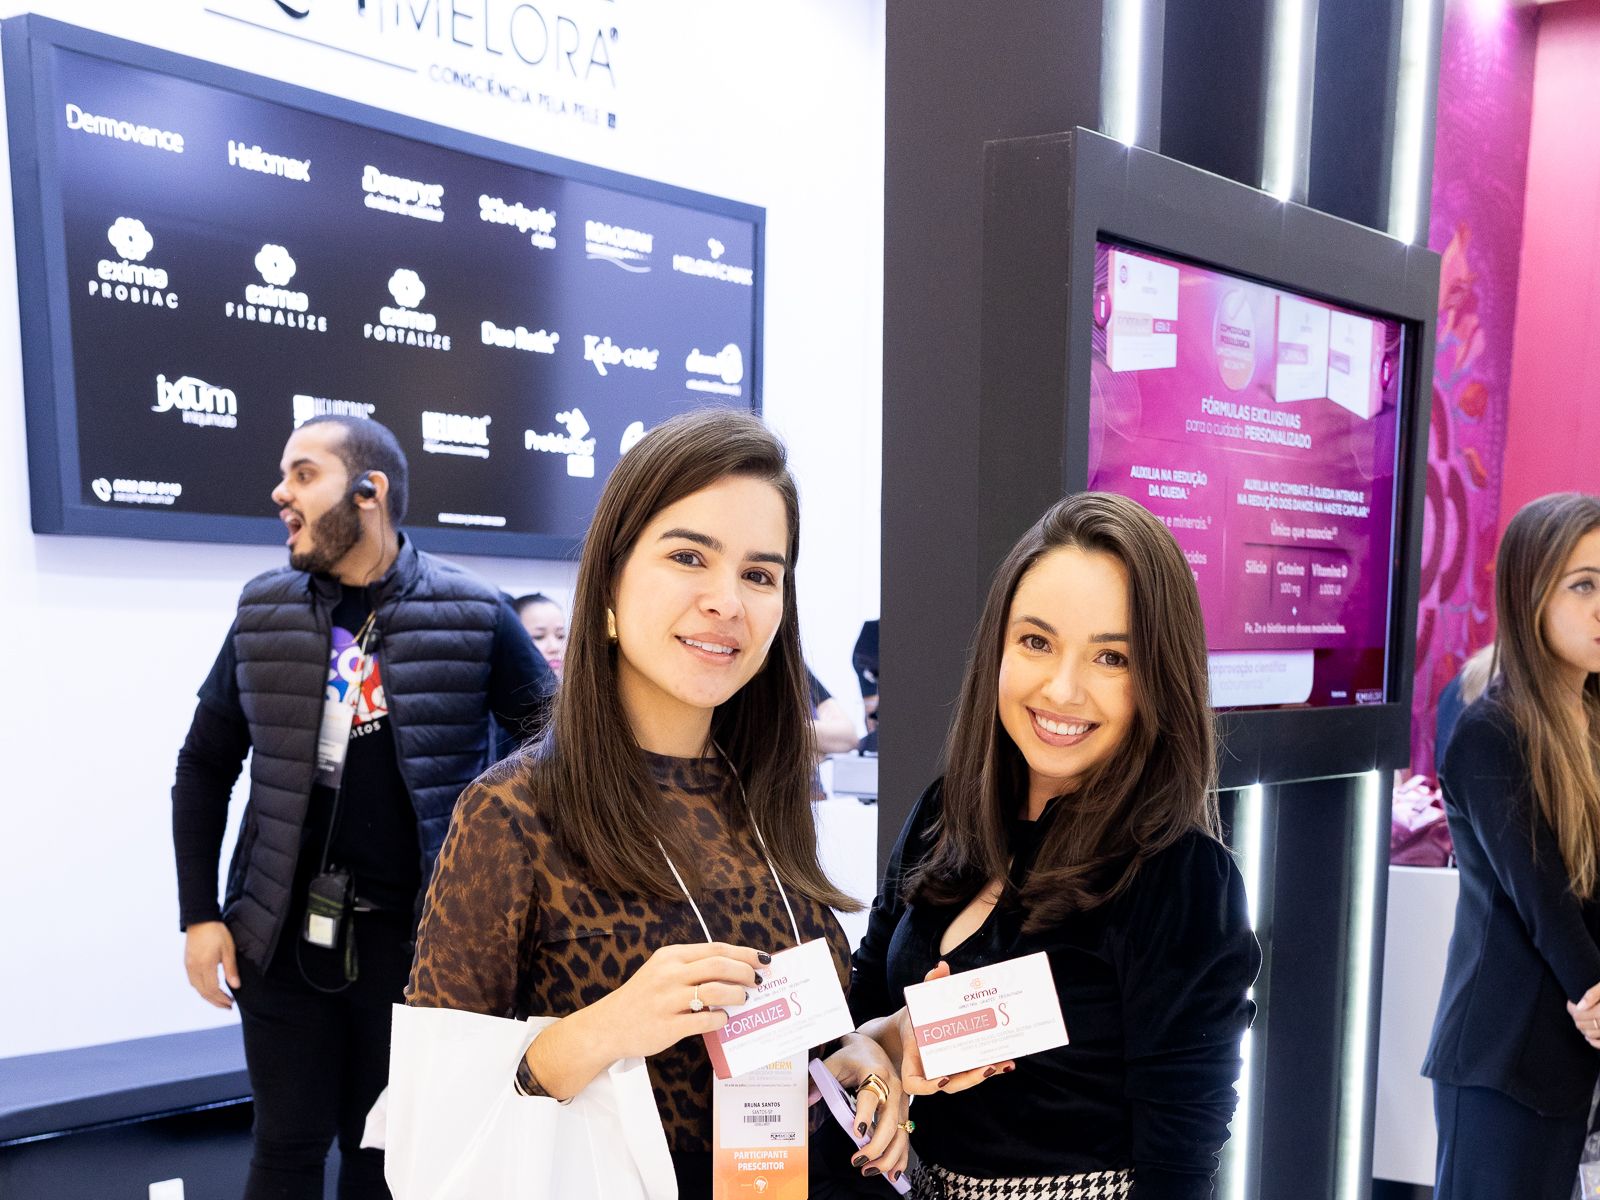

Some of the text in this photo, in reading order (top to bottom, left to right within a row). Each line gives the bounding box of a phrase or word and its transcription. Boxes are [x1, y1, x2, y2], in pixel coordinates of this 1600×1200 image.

[66, 103, 184, 153] Dermovance
[88, 279, 179, 309] PROBIAC
[225, 302, 328, 332] FIRMALIZE
[363, 323, 451, 351] FORTALIZE
[1201, 395, 1301, 430] FÓRMULAS EXCLUSIVAS
[1244, 425, 1311, 449] PERSONALIZADO
[723, 1003, 786, 1038] FORTALIZE
[789, 991, 802, 1016] S
[923, 1014, 990, 1042] FORTALIZE
[997, 1002, 1010, 1027] S
[733, 1151, 788, 1160] PARTICIPANTE
[737, 1161, 785, 1171] PRESCRITOR
